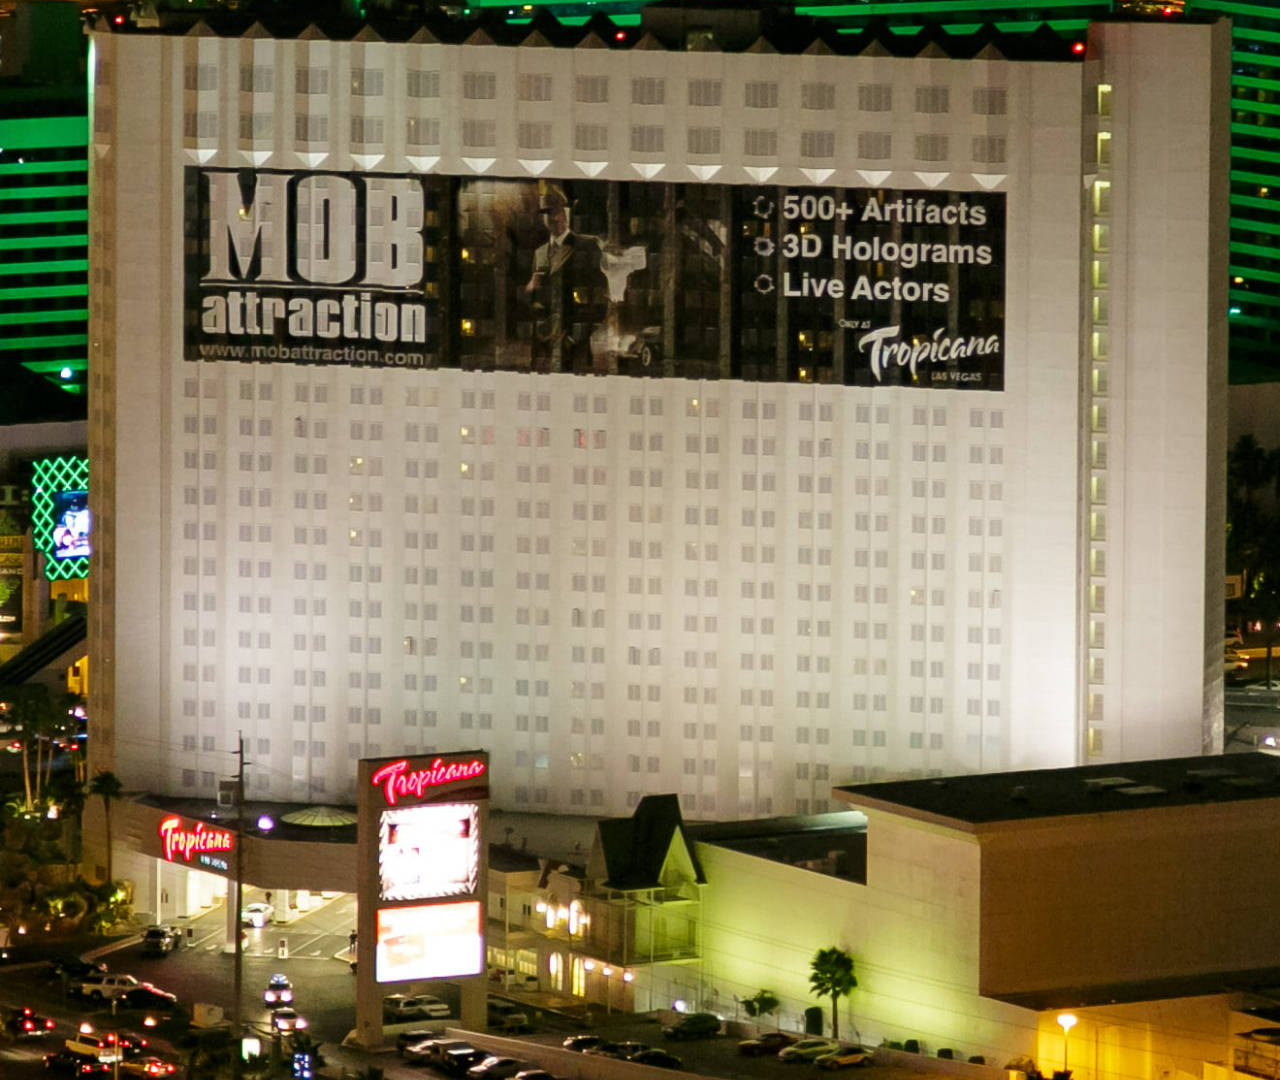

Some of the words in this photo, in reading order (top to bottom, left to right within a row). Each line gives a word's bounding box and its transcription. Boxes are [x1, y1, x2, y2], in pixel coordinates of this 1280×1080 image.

[200, 171, 424, 286] MOB
[783, 195, 853, 220] 500+
[861, 197, 987, 225] Artifacts
[782, 234, 822, 258] 3D
[832, 235, 992, 269] Holograms
[783, 272, 844, 298] Live
[851, 275, 950, 303] Actors
[201, 291, 426, 343] attraction
[199, 343, 424, 366] www.mobattraction.com
[858, 325, 1000, 382] Tropicana
[931, 372, 948, 381] LAS
[950, 372, 982, 382] VEGAS
[372, 759, 485, 806] Tropicana
[160, 815, 231, 862] Tropicana
